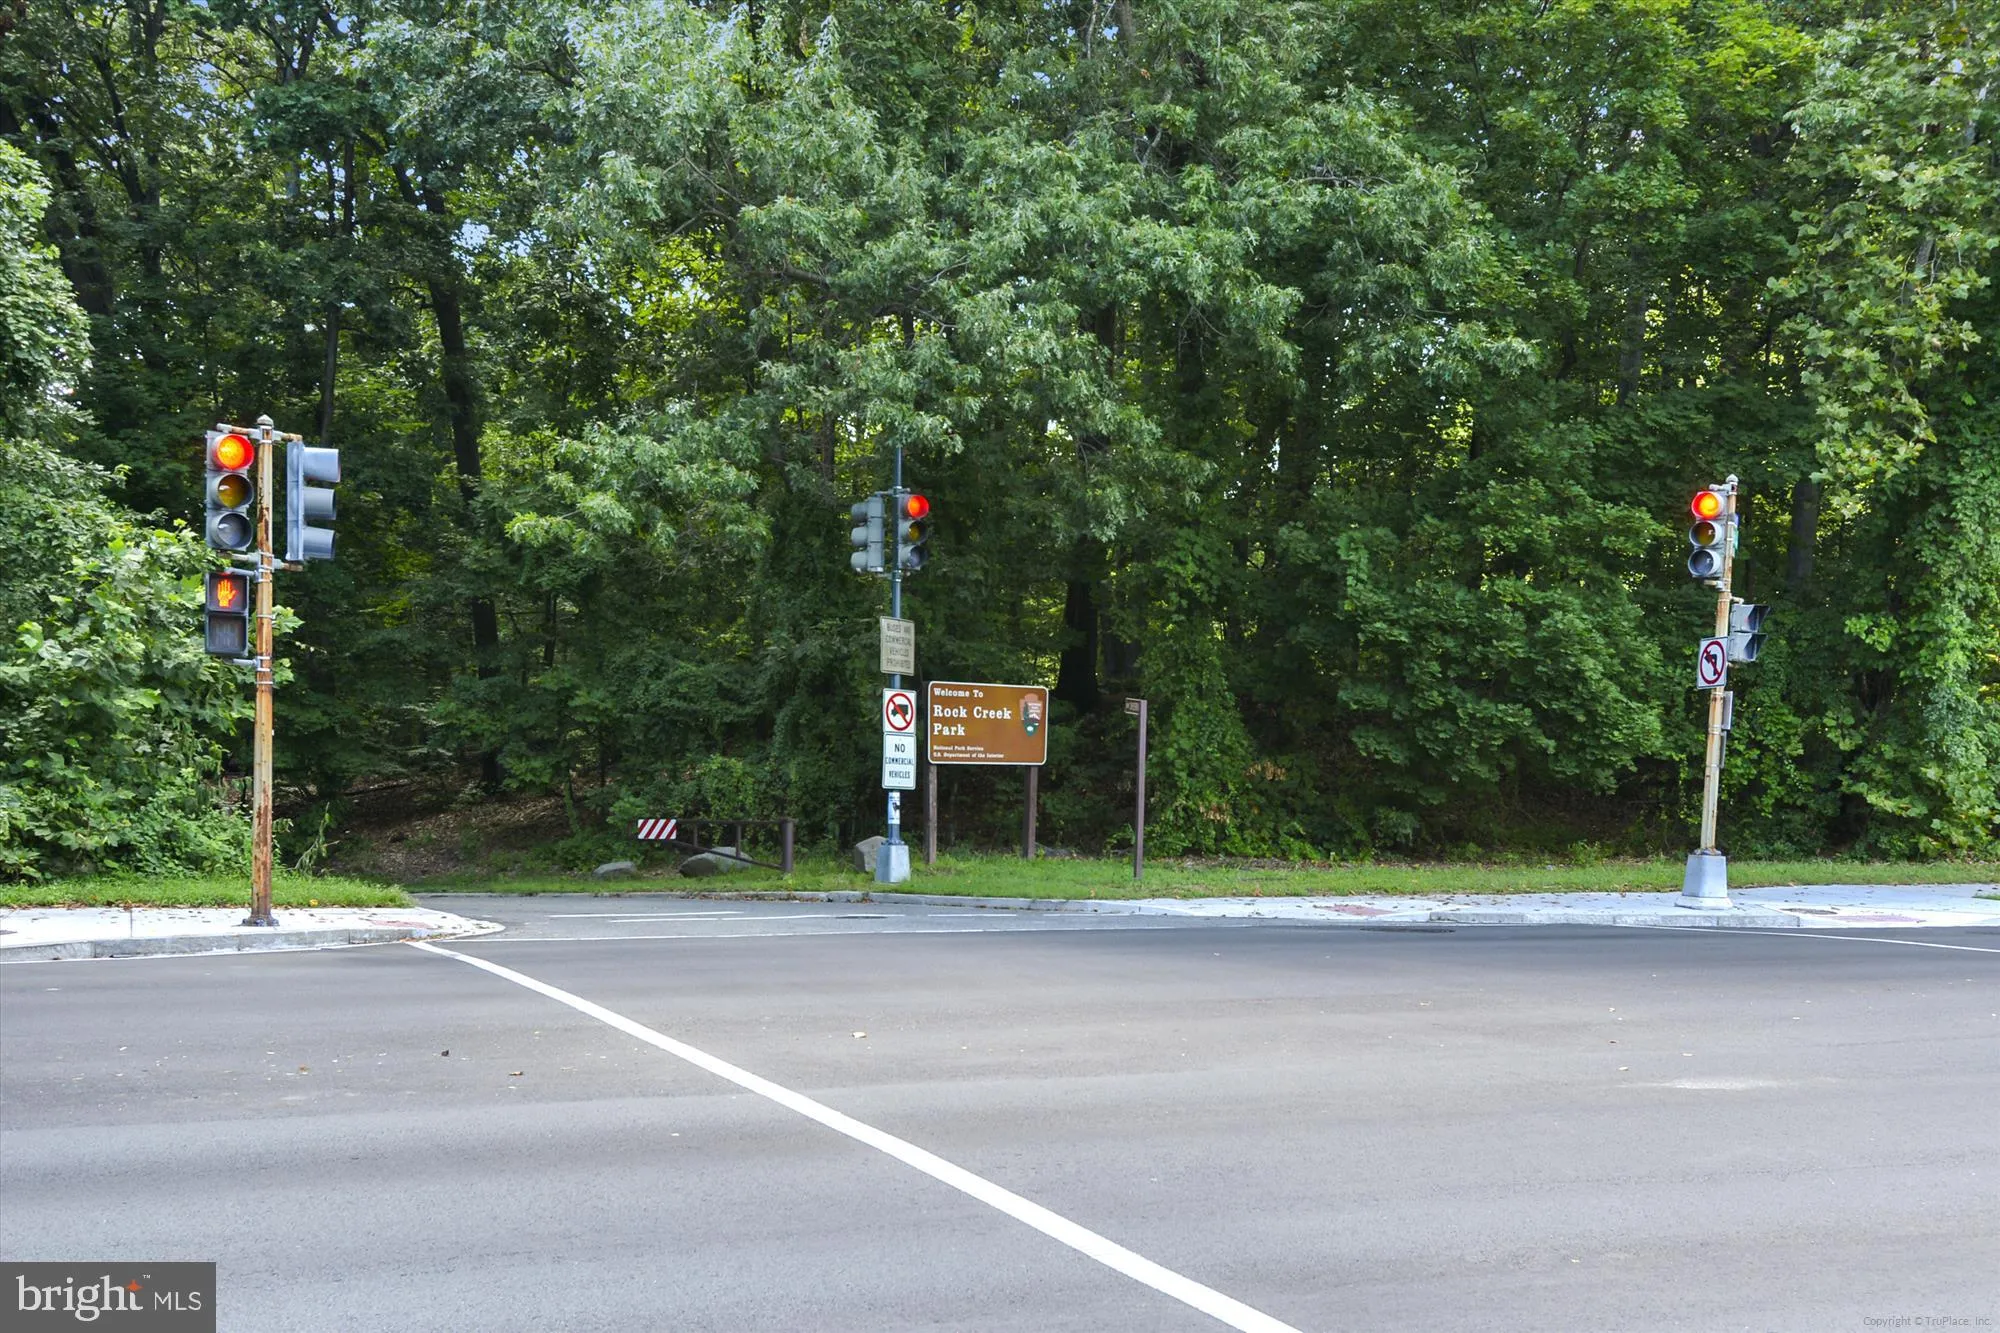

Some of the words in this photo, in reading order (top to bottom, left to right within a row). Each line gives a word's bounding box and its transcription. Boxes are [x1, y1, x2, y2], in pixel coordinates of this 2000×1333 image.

[933, 687, 970, 698] Welcome
[972, 689, 984, 698] To
[933, 704, 968, 718] Rock
[973, 706, 1012, 720] Creek
[933, 723, 966, 736] Park
[894, 743, 906, 753] NO
[885, 757, 914, 765] COMMERCIAL
[888, 771, 910, 779] VEHICLES
